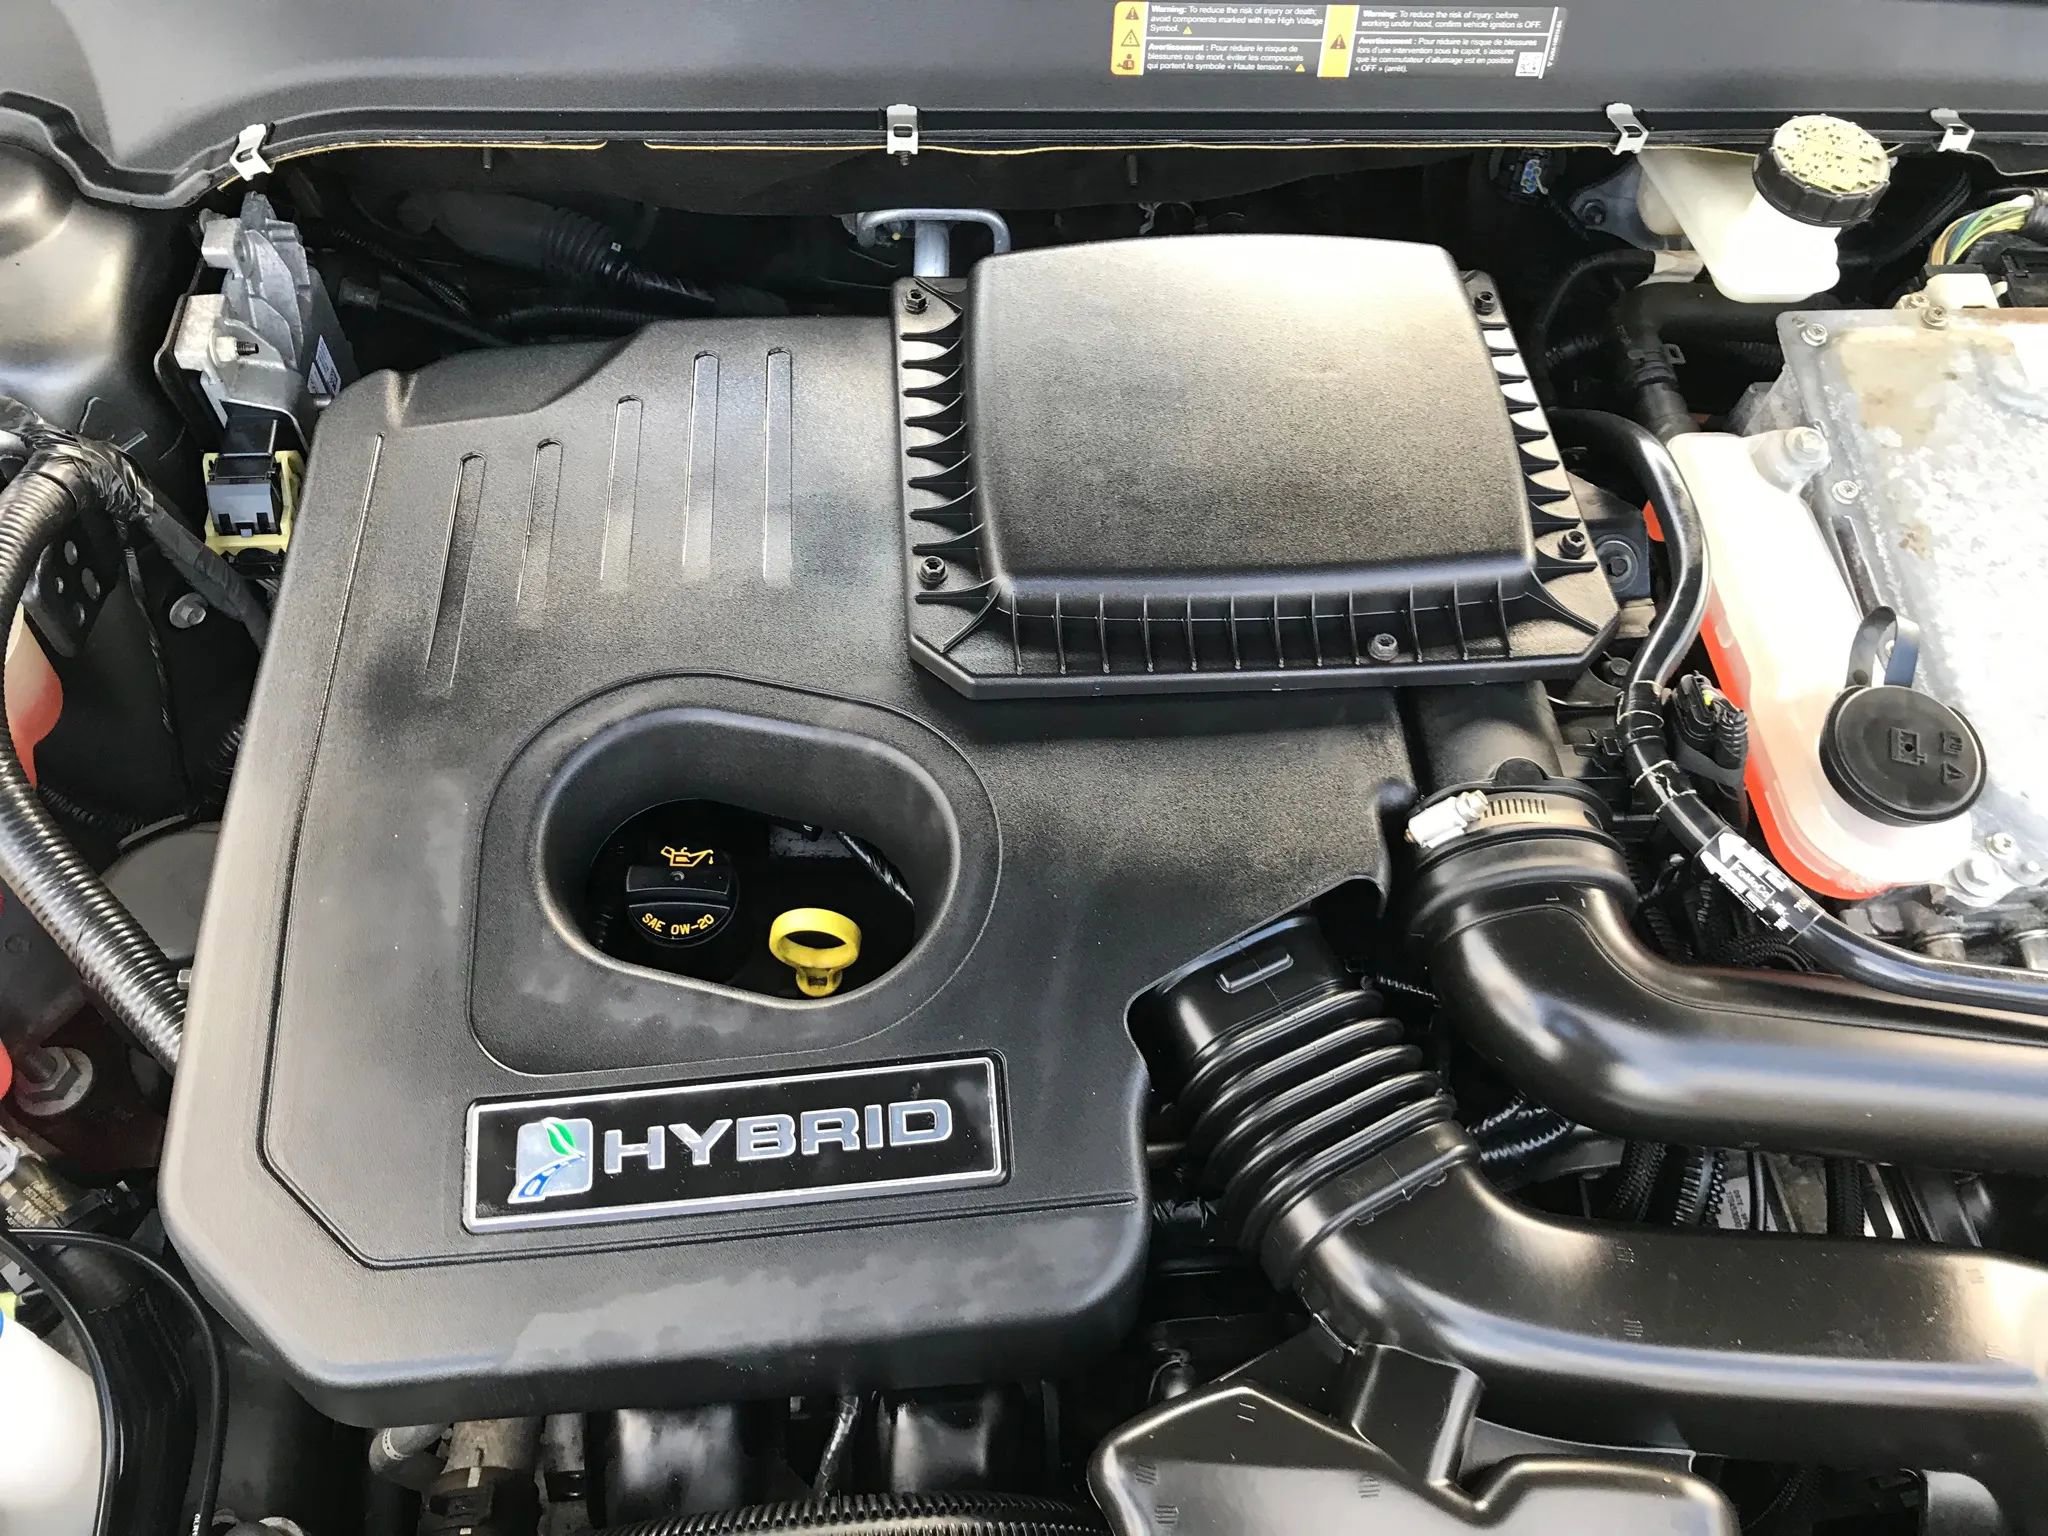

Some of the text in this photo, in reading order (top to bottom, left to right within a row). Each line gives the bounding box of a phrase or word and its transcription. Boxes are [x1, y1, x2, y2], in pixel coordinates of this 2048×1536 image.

[1151, 5, 1187, 14] Warning:
[1264, 7, 1283, 16] injury
[1363, 10, 1397, 19] Warning:
[1278, 17, 1294, 26] High
[1297, 17, 1323, 26] Voltage
[1489, 21, 1515, 29] ignition
[1265, 45, 1287, 53] risque
[1260, 55, 1303, 63] composants
[1736, 864, 1771, 898] FoMoCo
[641, 912, 666, 933] SAE
[604, 1099, 953, 1174] HYBRID
